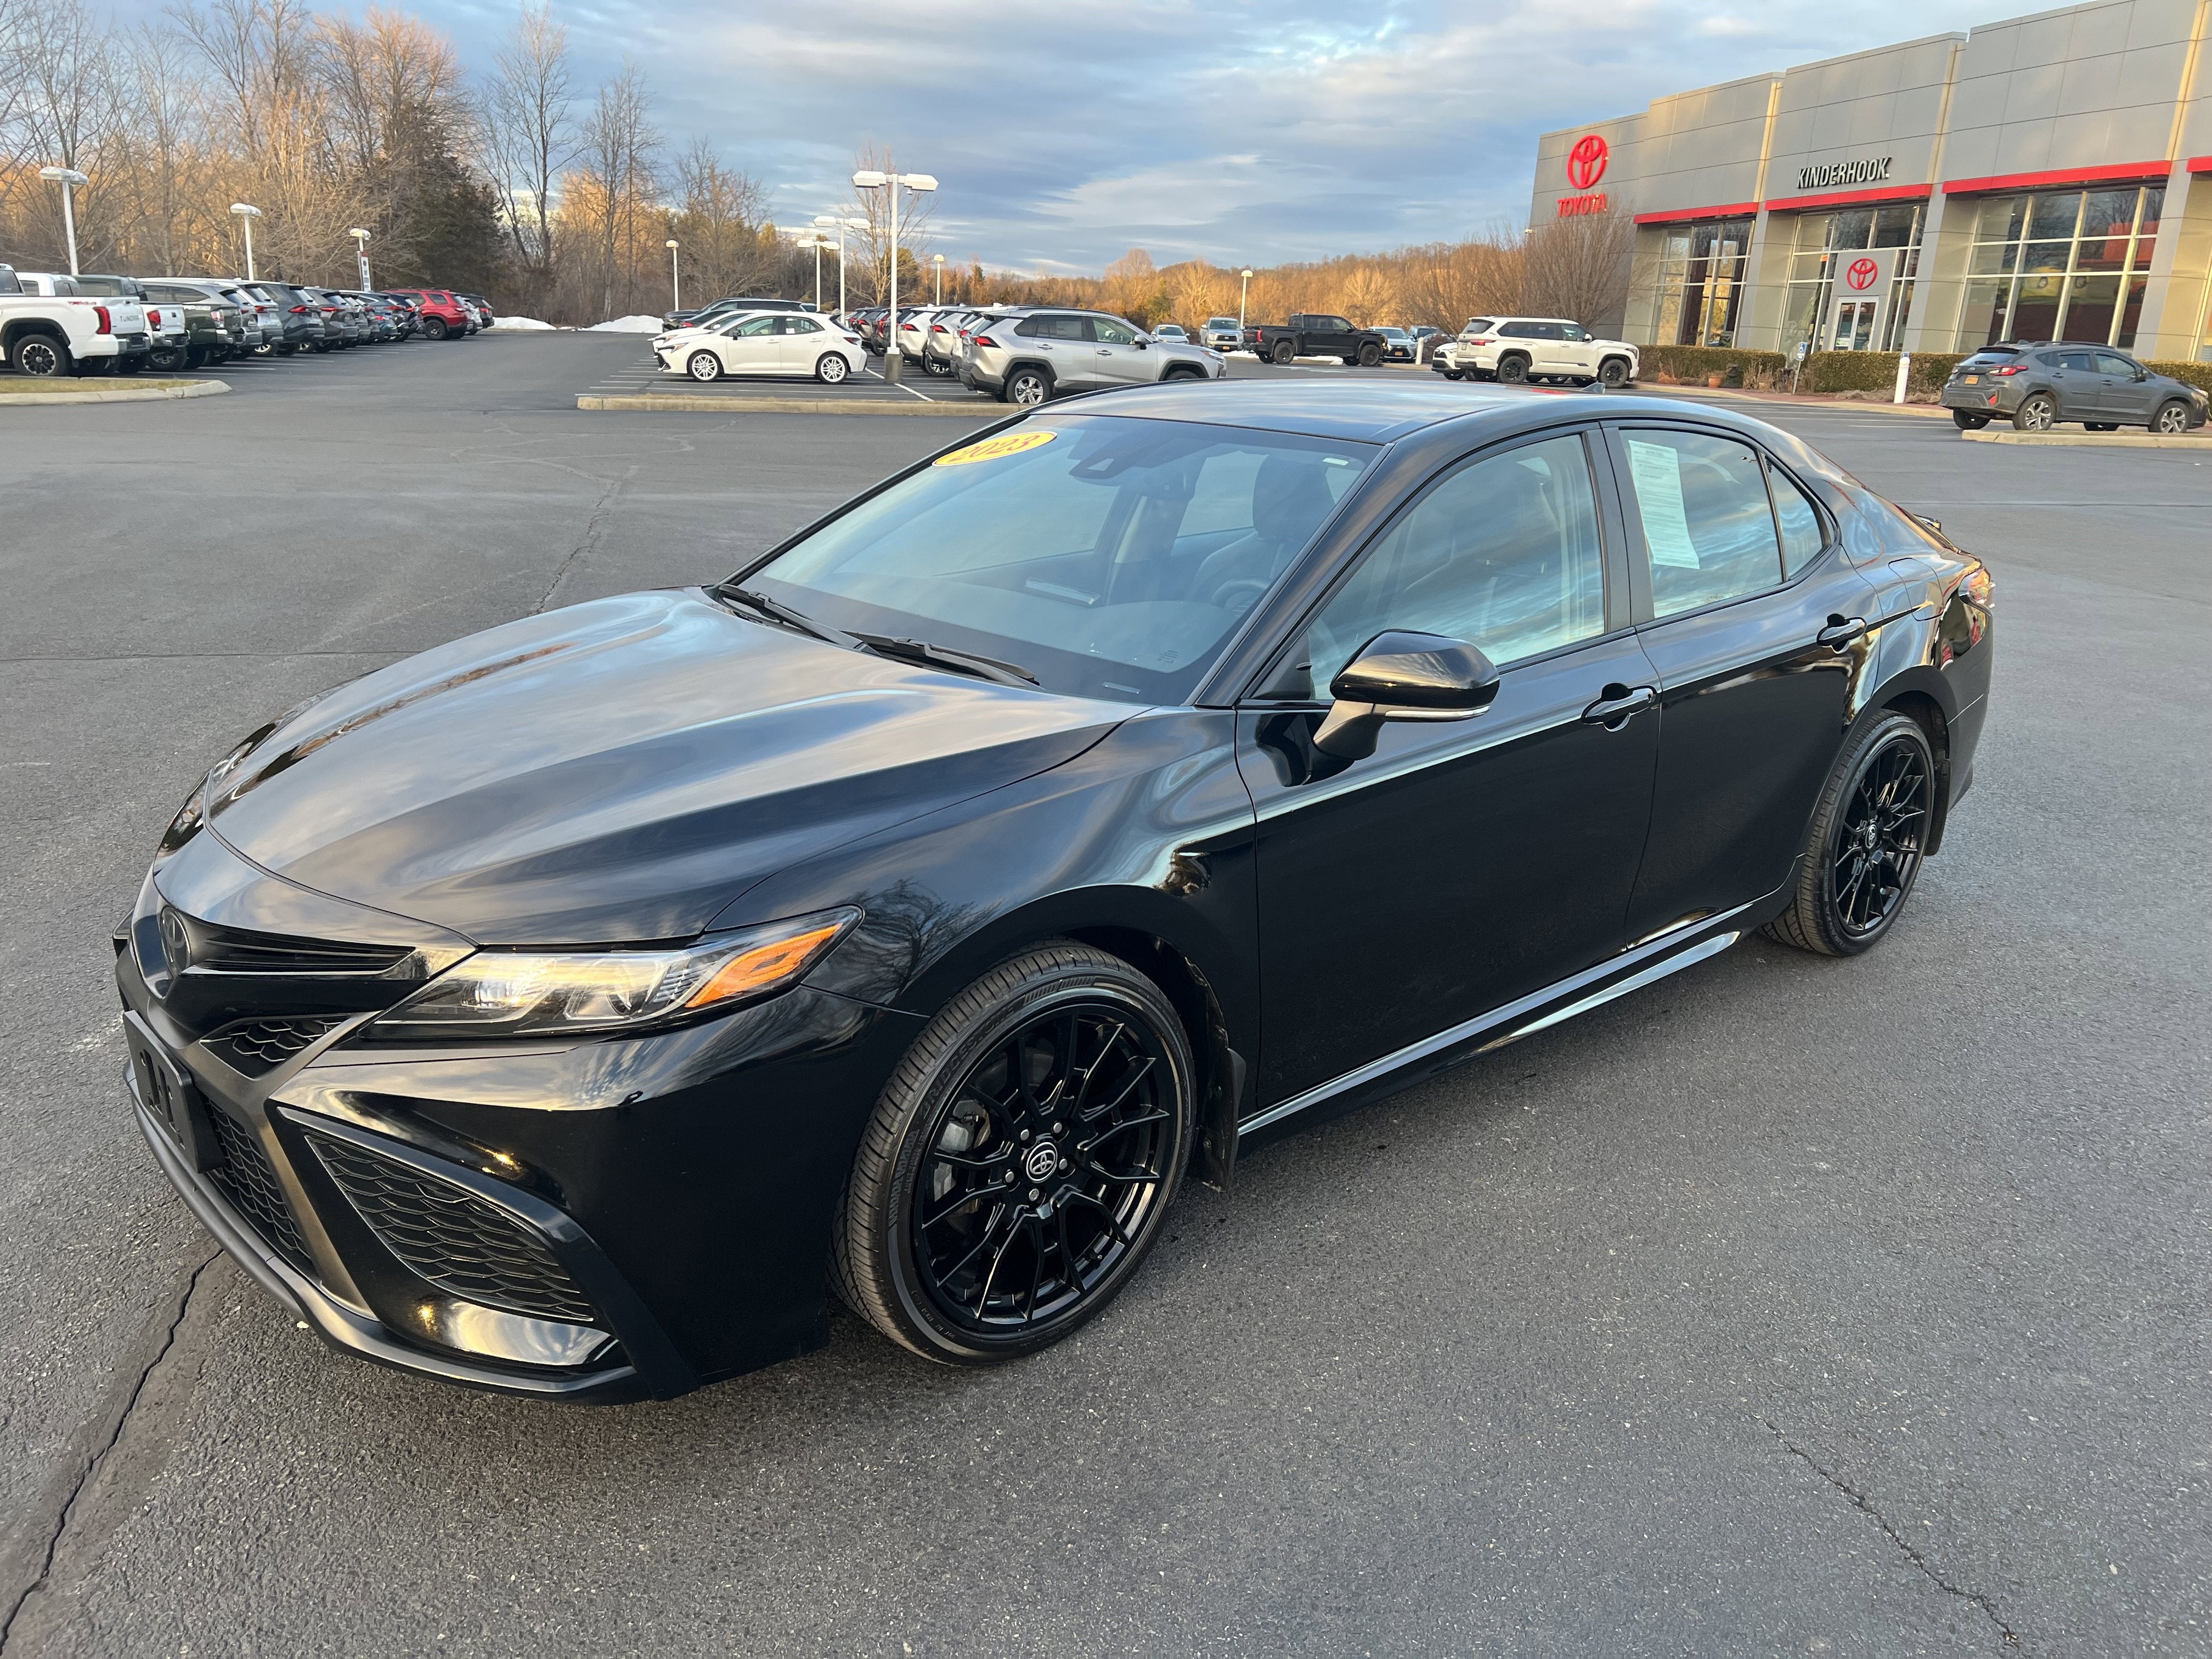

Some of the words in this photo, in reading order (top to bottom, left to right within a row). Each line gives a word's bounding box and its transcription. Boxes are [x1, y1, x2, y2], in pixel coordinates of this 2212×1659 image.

[1797, 157, 1892, 189] KINDERHOOK
[1557, 193, 1606, 217] TOYOTA
[947, 435, 1041, 462] 2023
